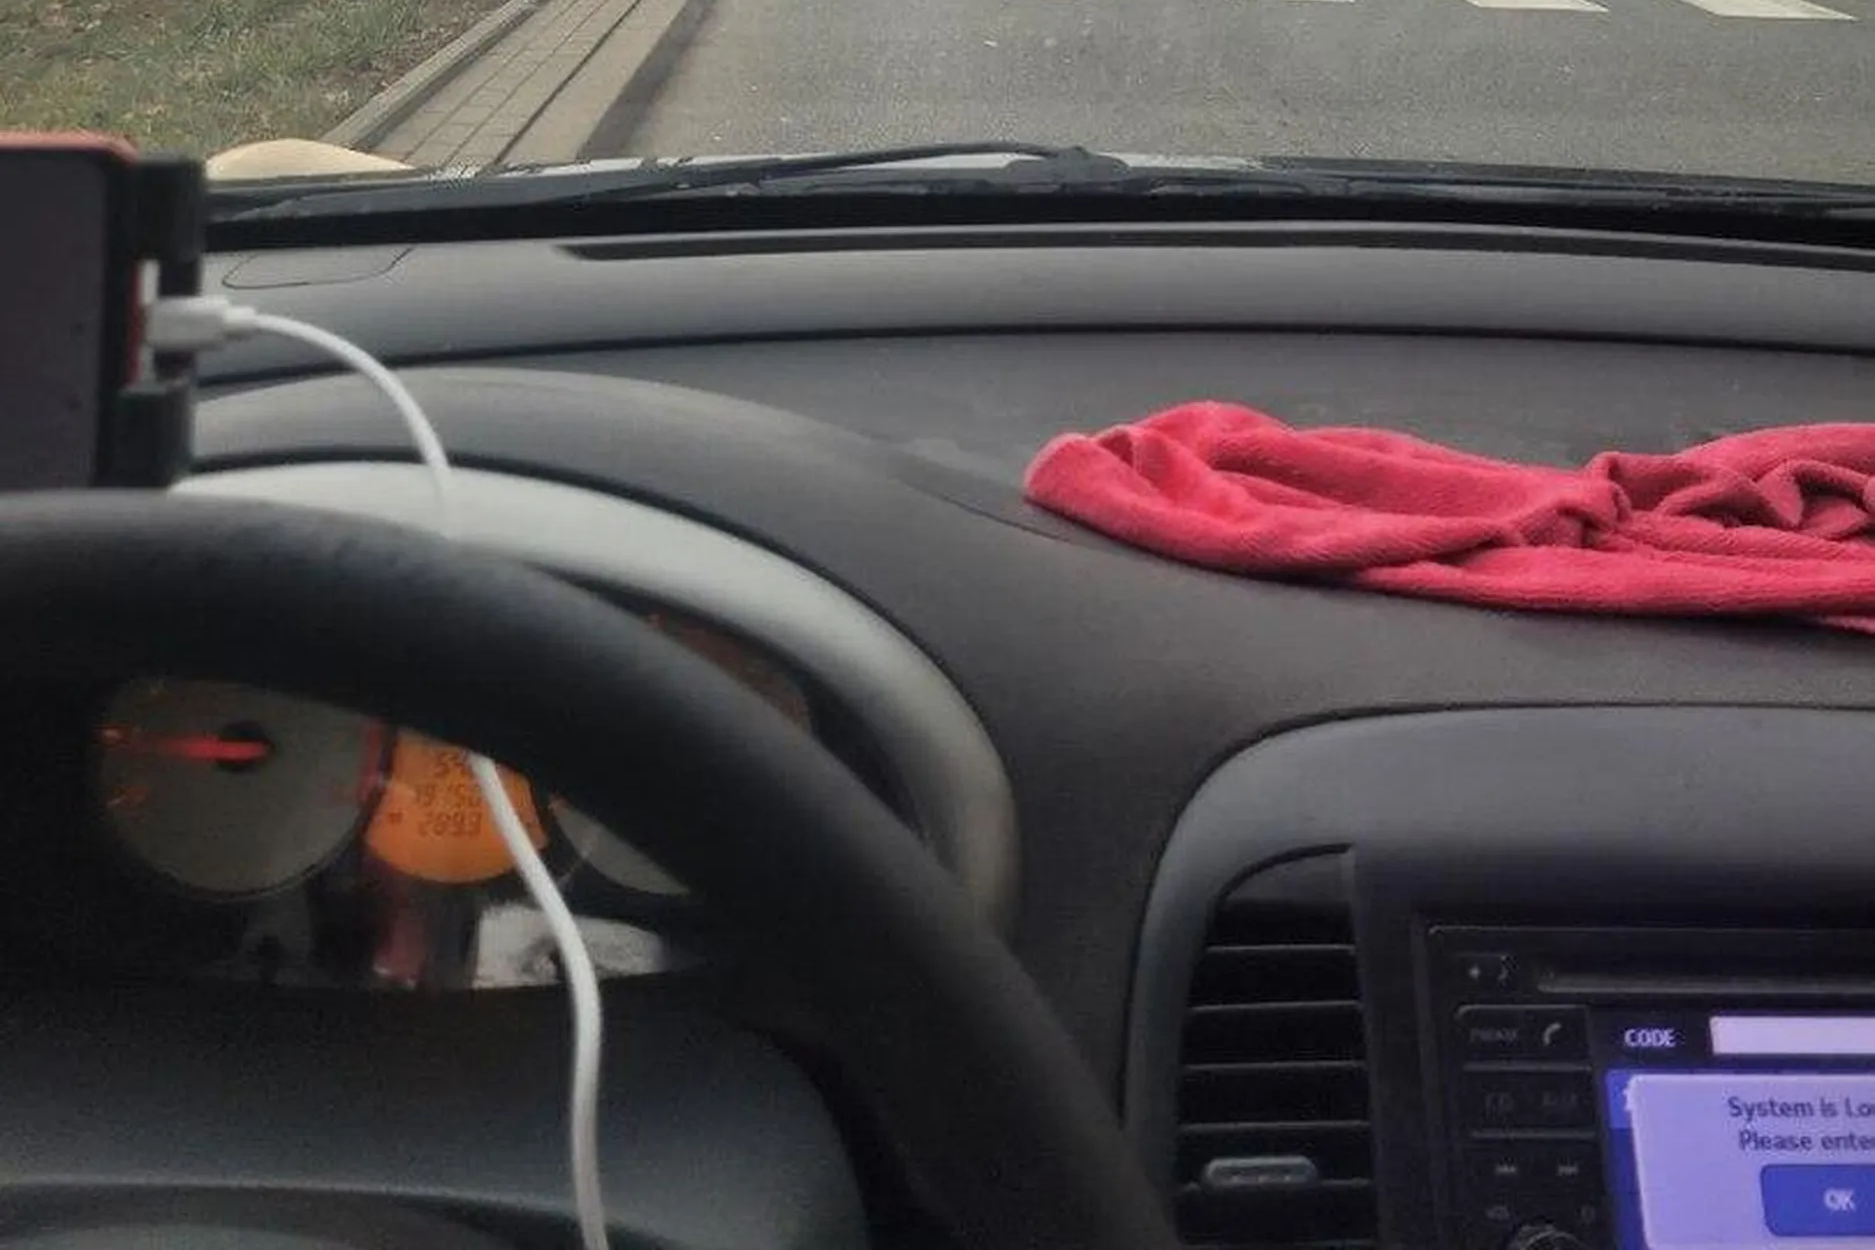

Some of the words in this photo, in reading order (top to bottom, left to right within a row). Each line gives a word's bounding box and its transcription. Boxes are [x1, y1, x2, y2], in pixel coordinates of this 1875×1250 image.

[1624, 1028, 1676, 1047] CODE
[1728, 1097, 1813, 1122] System
[1821, 1096, 1838, 1118] is
[1739, 1130, 1813, 1151] Please
[1823, 1189, 1856, 1211] OK
